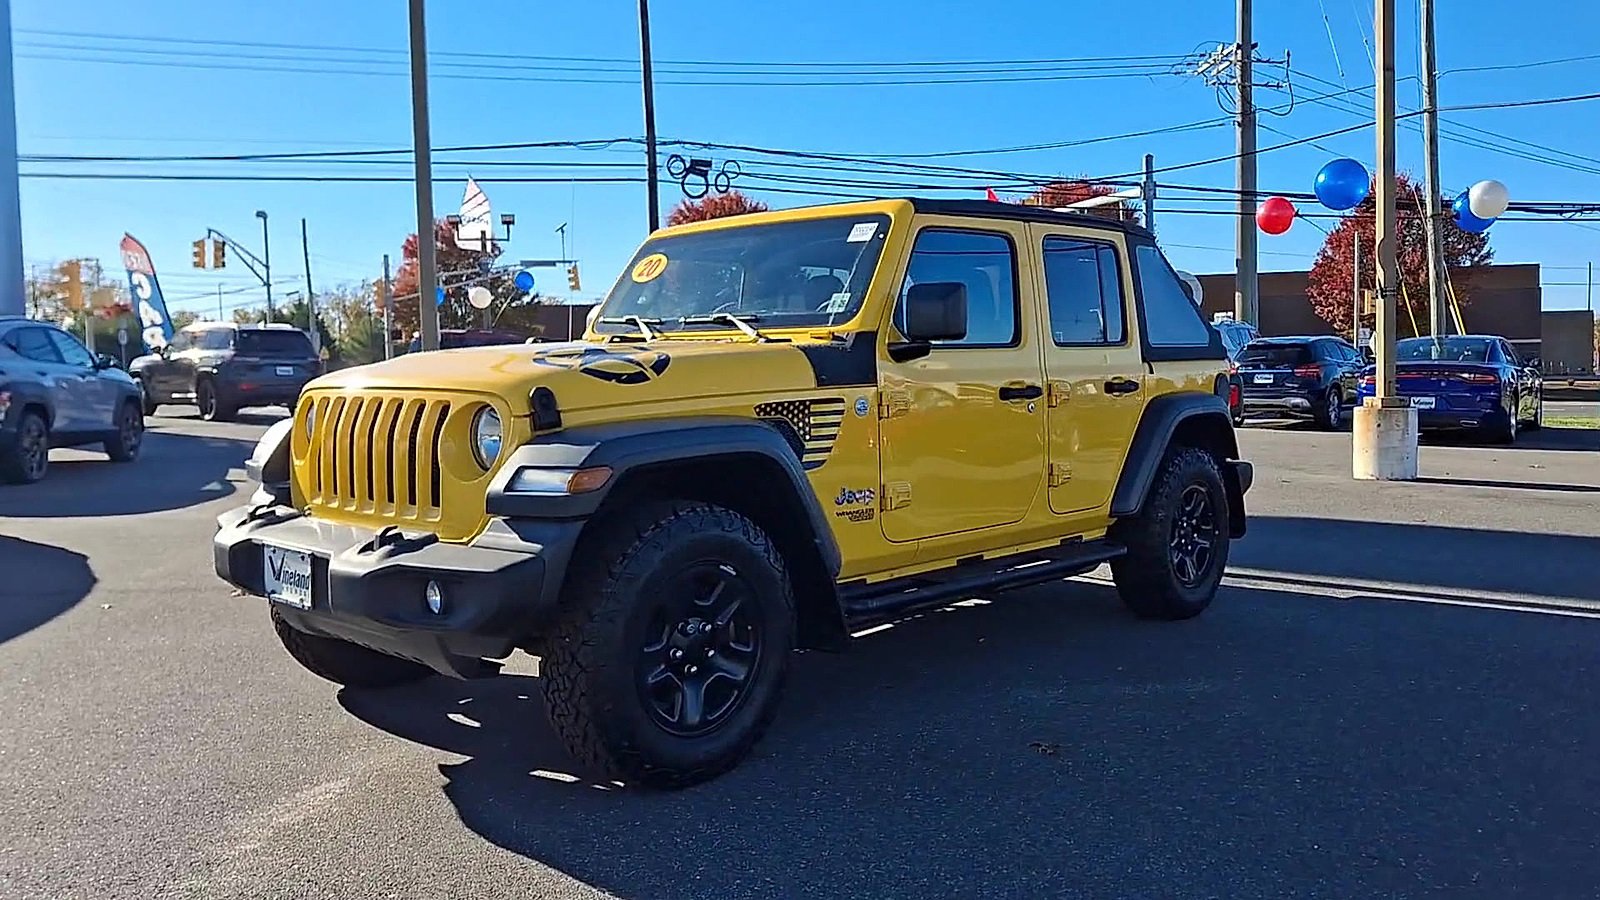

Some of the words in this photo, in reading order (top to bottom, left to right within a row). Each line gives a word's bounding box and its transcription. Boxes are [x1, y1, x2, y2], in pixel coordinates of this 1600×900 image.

[637, 257, 662, 277] 20
[834, 486, 876, 506] Jeep
[268, 552, 311, 590] Vineland
